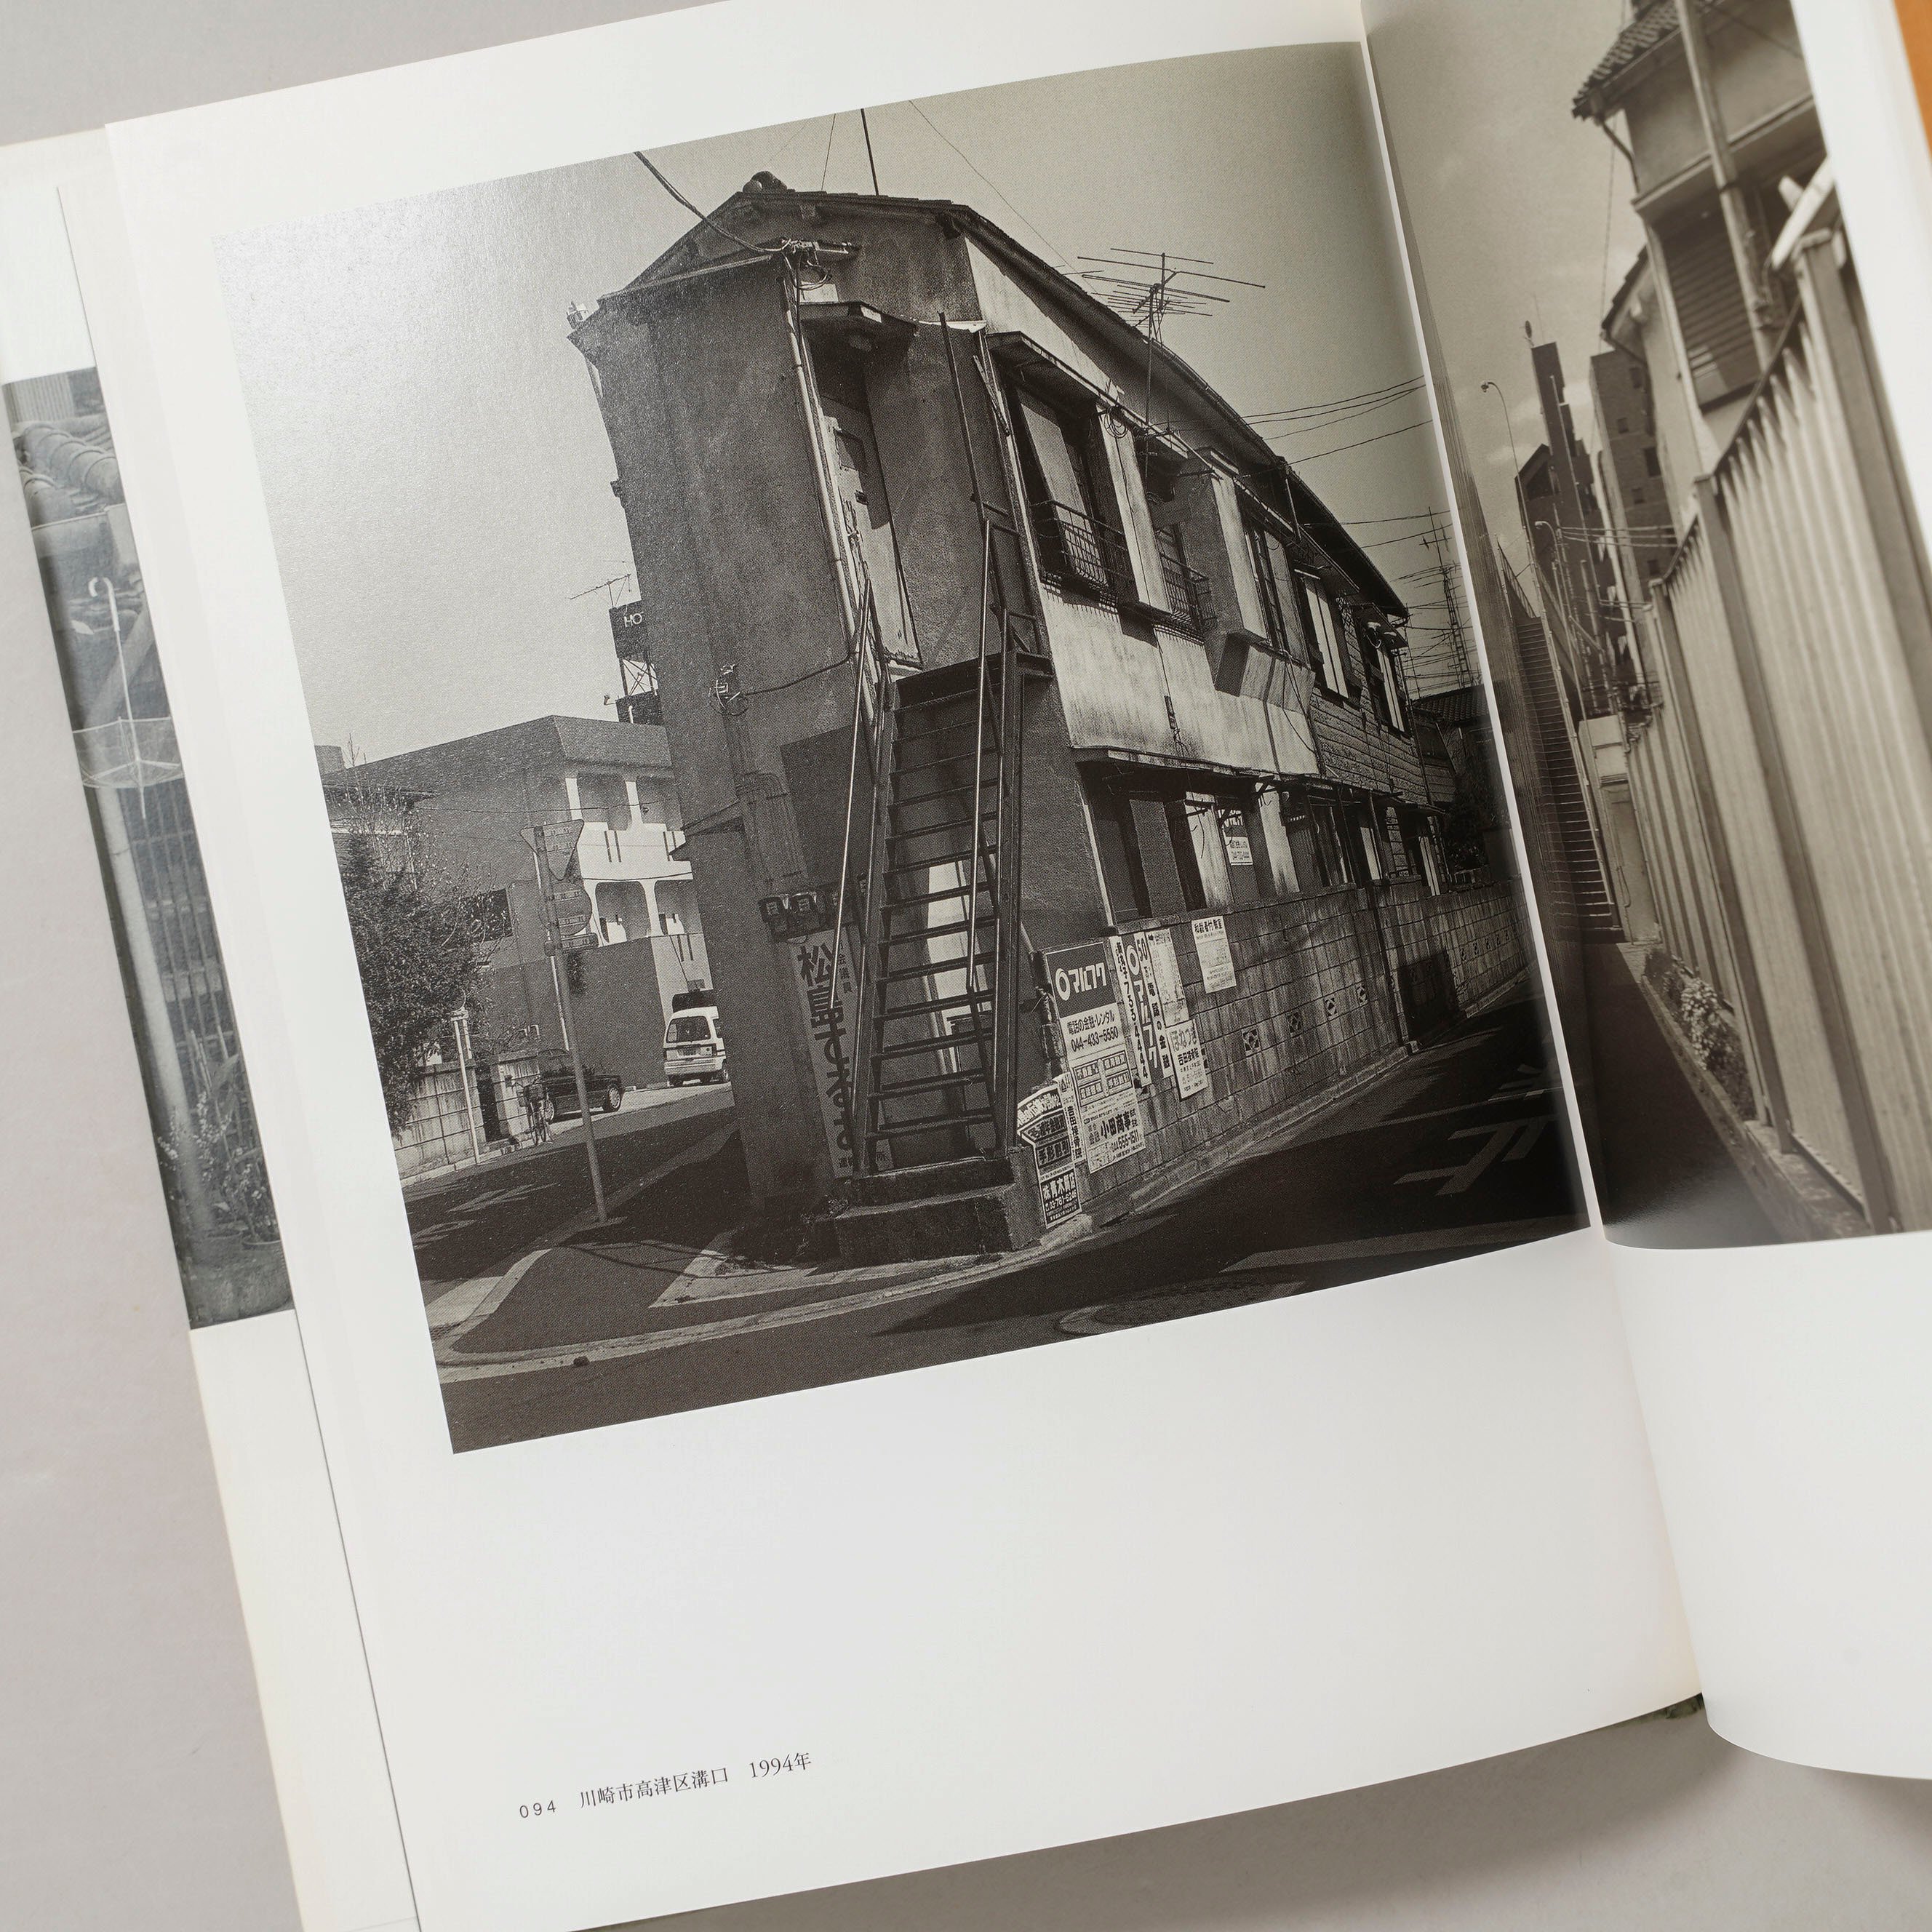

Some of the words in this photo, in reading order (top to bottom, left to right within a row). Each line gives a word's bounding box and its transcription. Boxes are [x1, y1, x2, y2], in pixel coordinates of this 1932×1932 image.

[623, 612, 644, 627] HO
[519, 1800, 556, 1819] 094
[580, 1768, 728, 1808] 川崎市高津区溝口
[749, 1752, 812, 1779] 1994年
